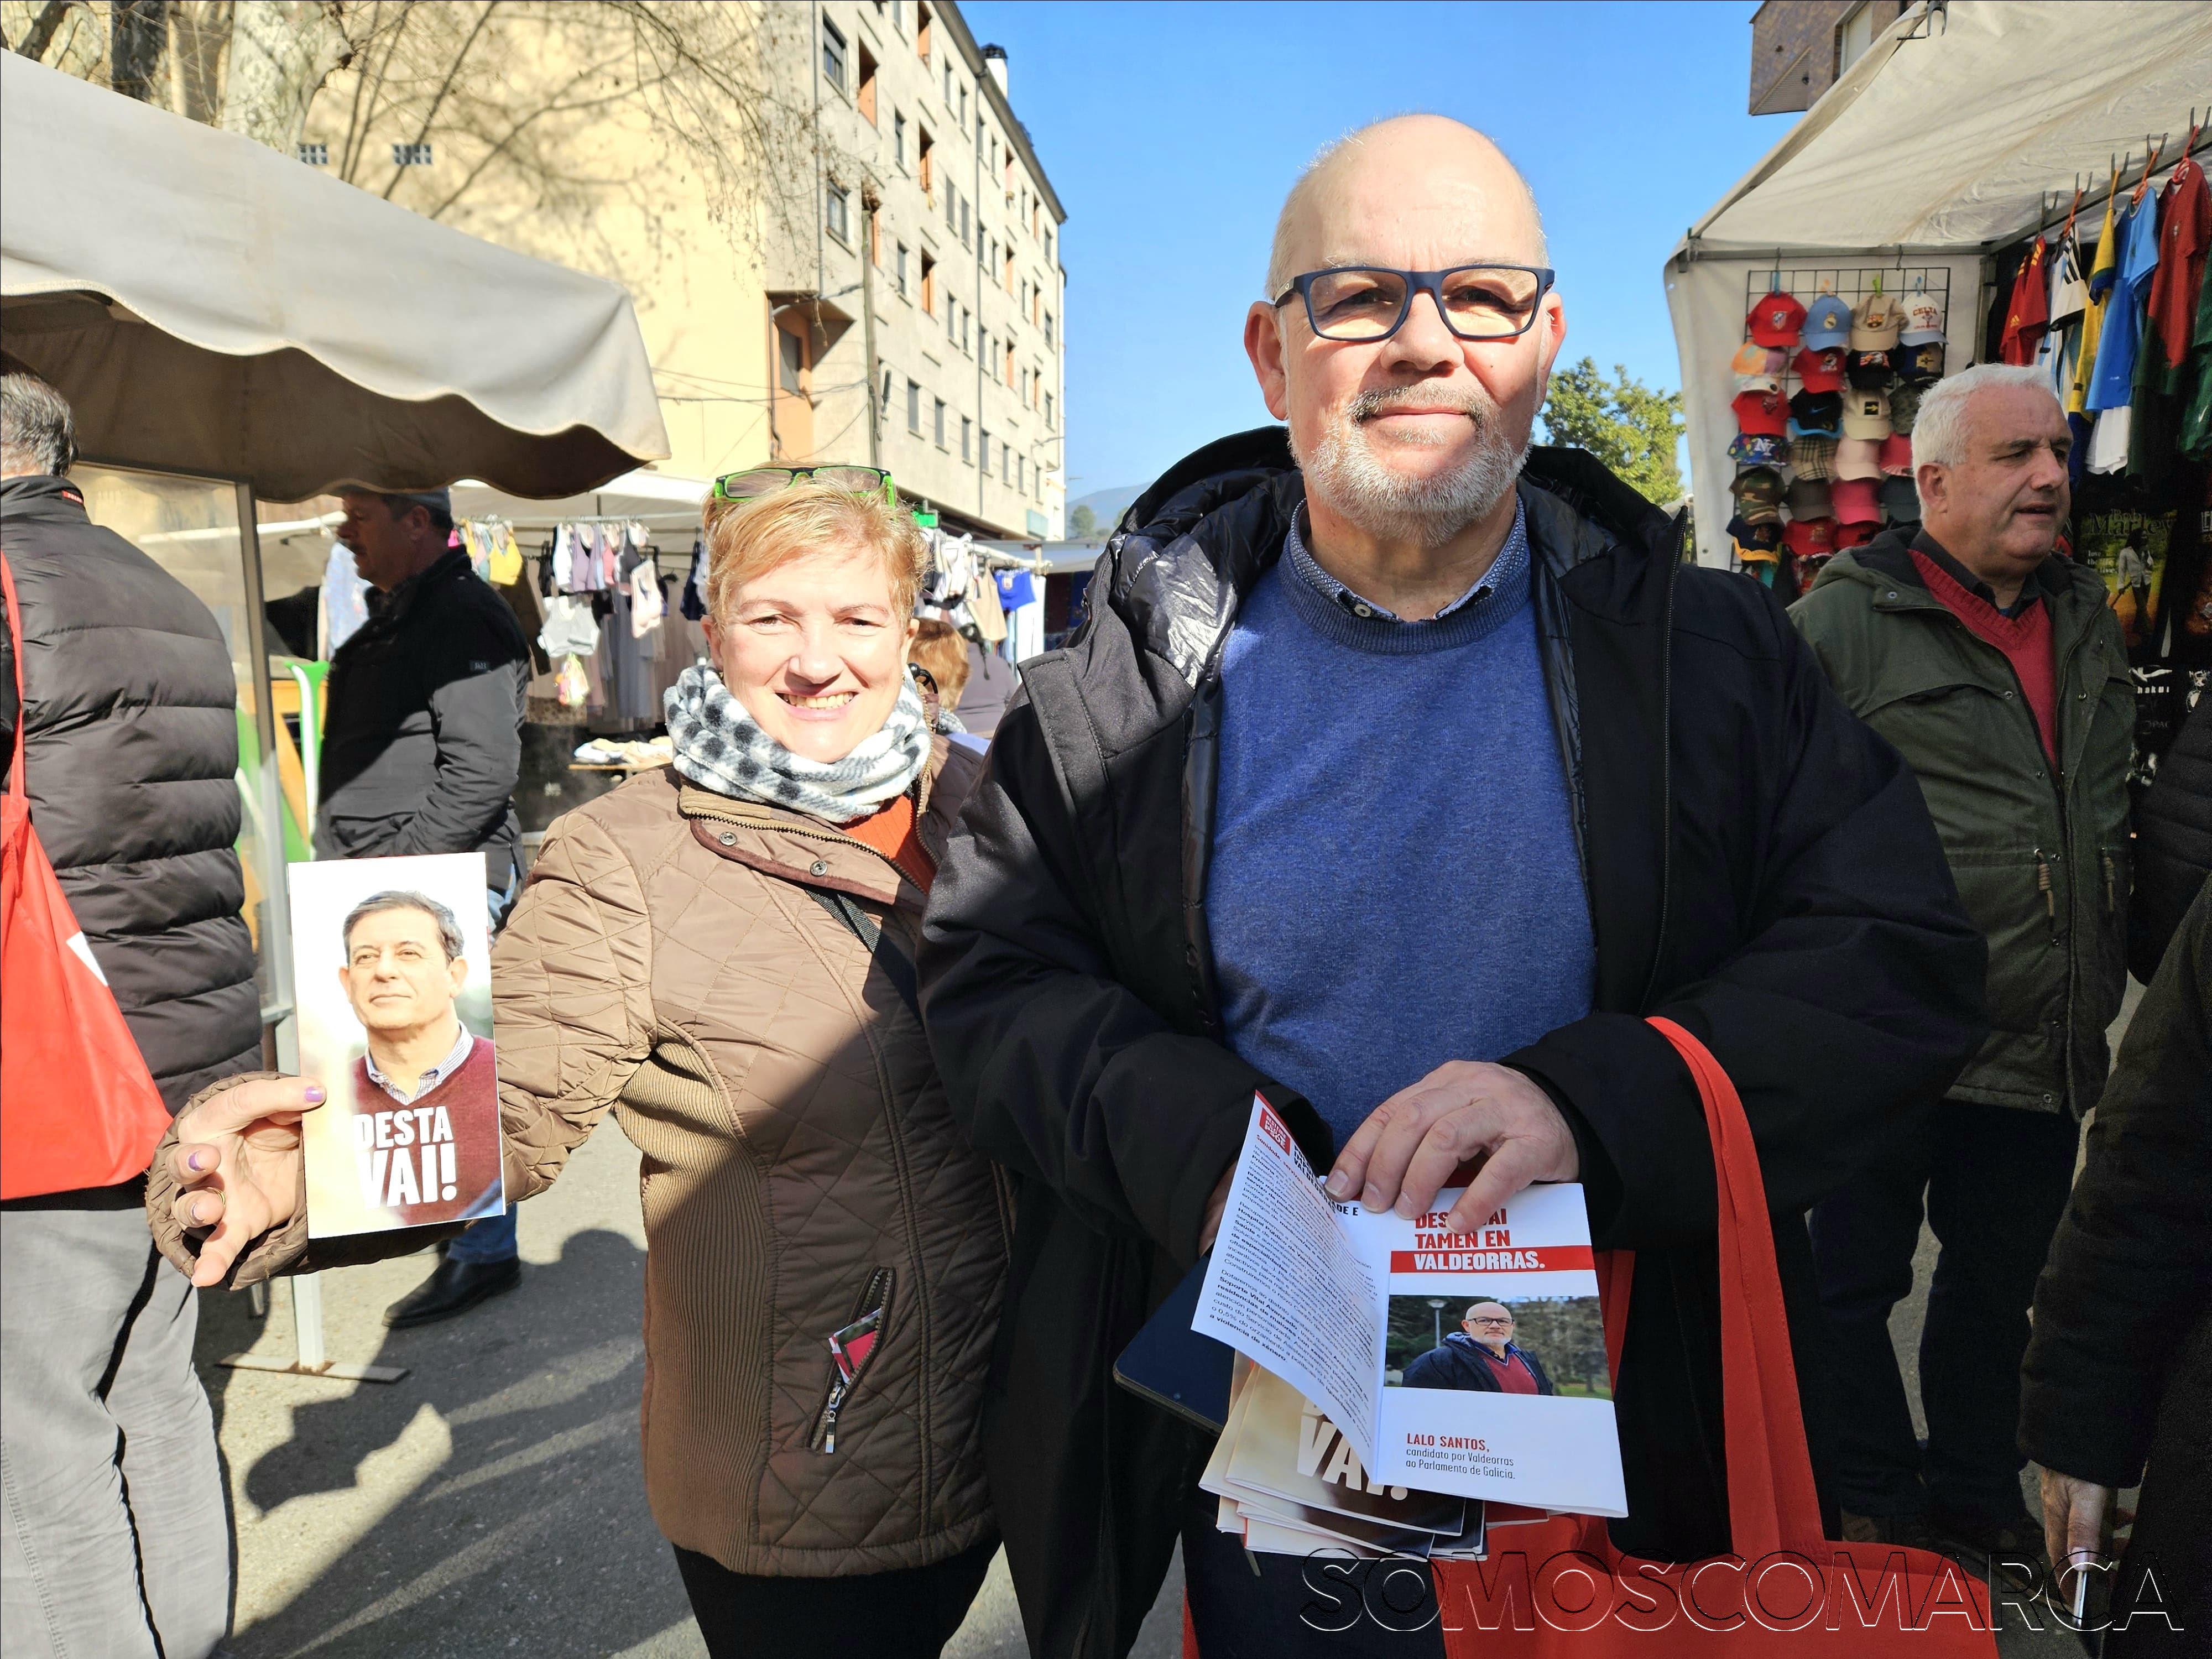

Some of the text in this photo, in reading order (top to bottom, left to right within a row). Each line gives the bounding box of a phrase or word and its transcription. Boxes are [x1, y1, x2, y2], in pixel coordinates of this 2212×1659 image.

[1912, 306, 1938, 316] CELTA
[2111, 508, 2142, 520] Bob
[353, 1105, 453, 1149] DESTA
[355, 1142, 457, 1209] VAI!
[1238, 1207, 1264, 1227] Hospital
[1415, 1208, 1507, 1229] DES AI
[1485, 1229, 1510, 1247] EN
[1413, 1250, 1546, 1270] VALDEORRAS.
[1221, 1269, 1258, 1292] Dotaremos
[1224, 1259, 1270, 1289] Construiremos
[1215, 1292, 1245, 1308] atención
[1217, 1284, 1258, 1308] residencias
[1219, 1276, 1248, 1293] Soporte
[1250, 1292, 1264, 1305] Vital
[1213, 1299, 1233, 1311] custo
[1218, 1308, 1237, 1321] 0,5%
[1217, 1317, 1249, 1337] violencia
[1407, 1433, 1489, 1453] LALO SANTOS,
[1406, 1448, 1514, 1466] candidato por Valdeorras
[1406, 1459, 1516, 1479] ao Parlamento de Galicia.
